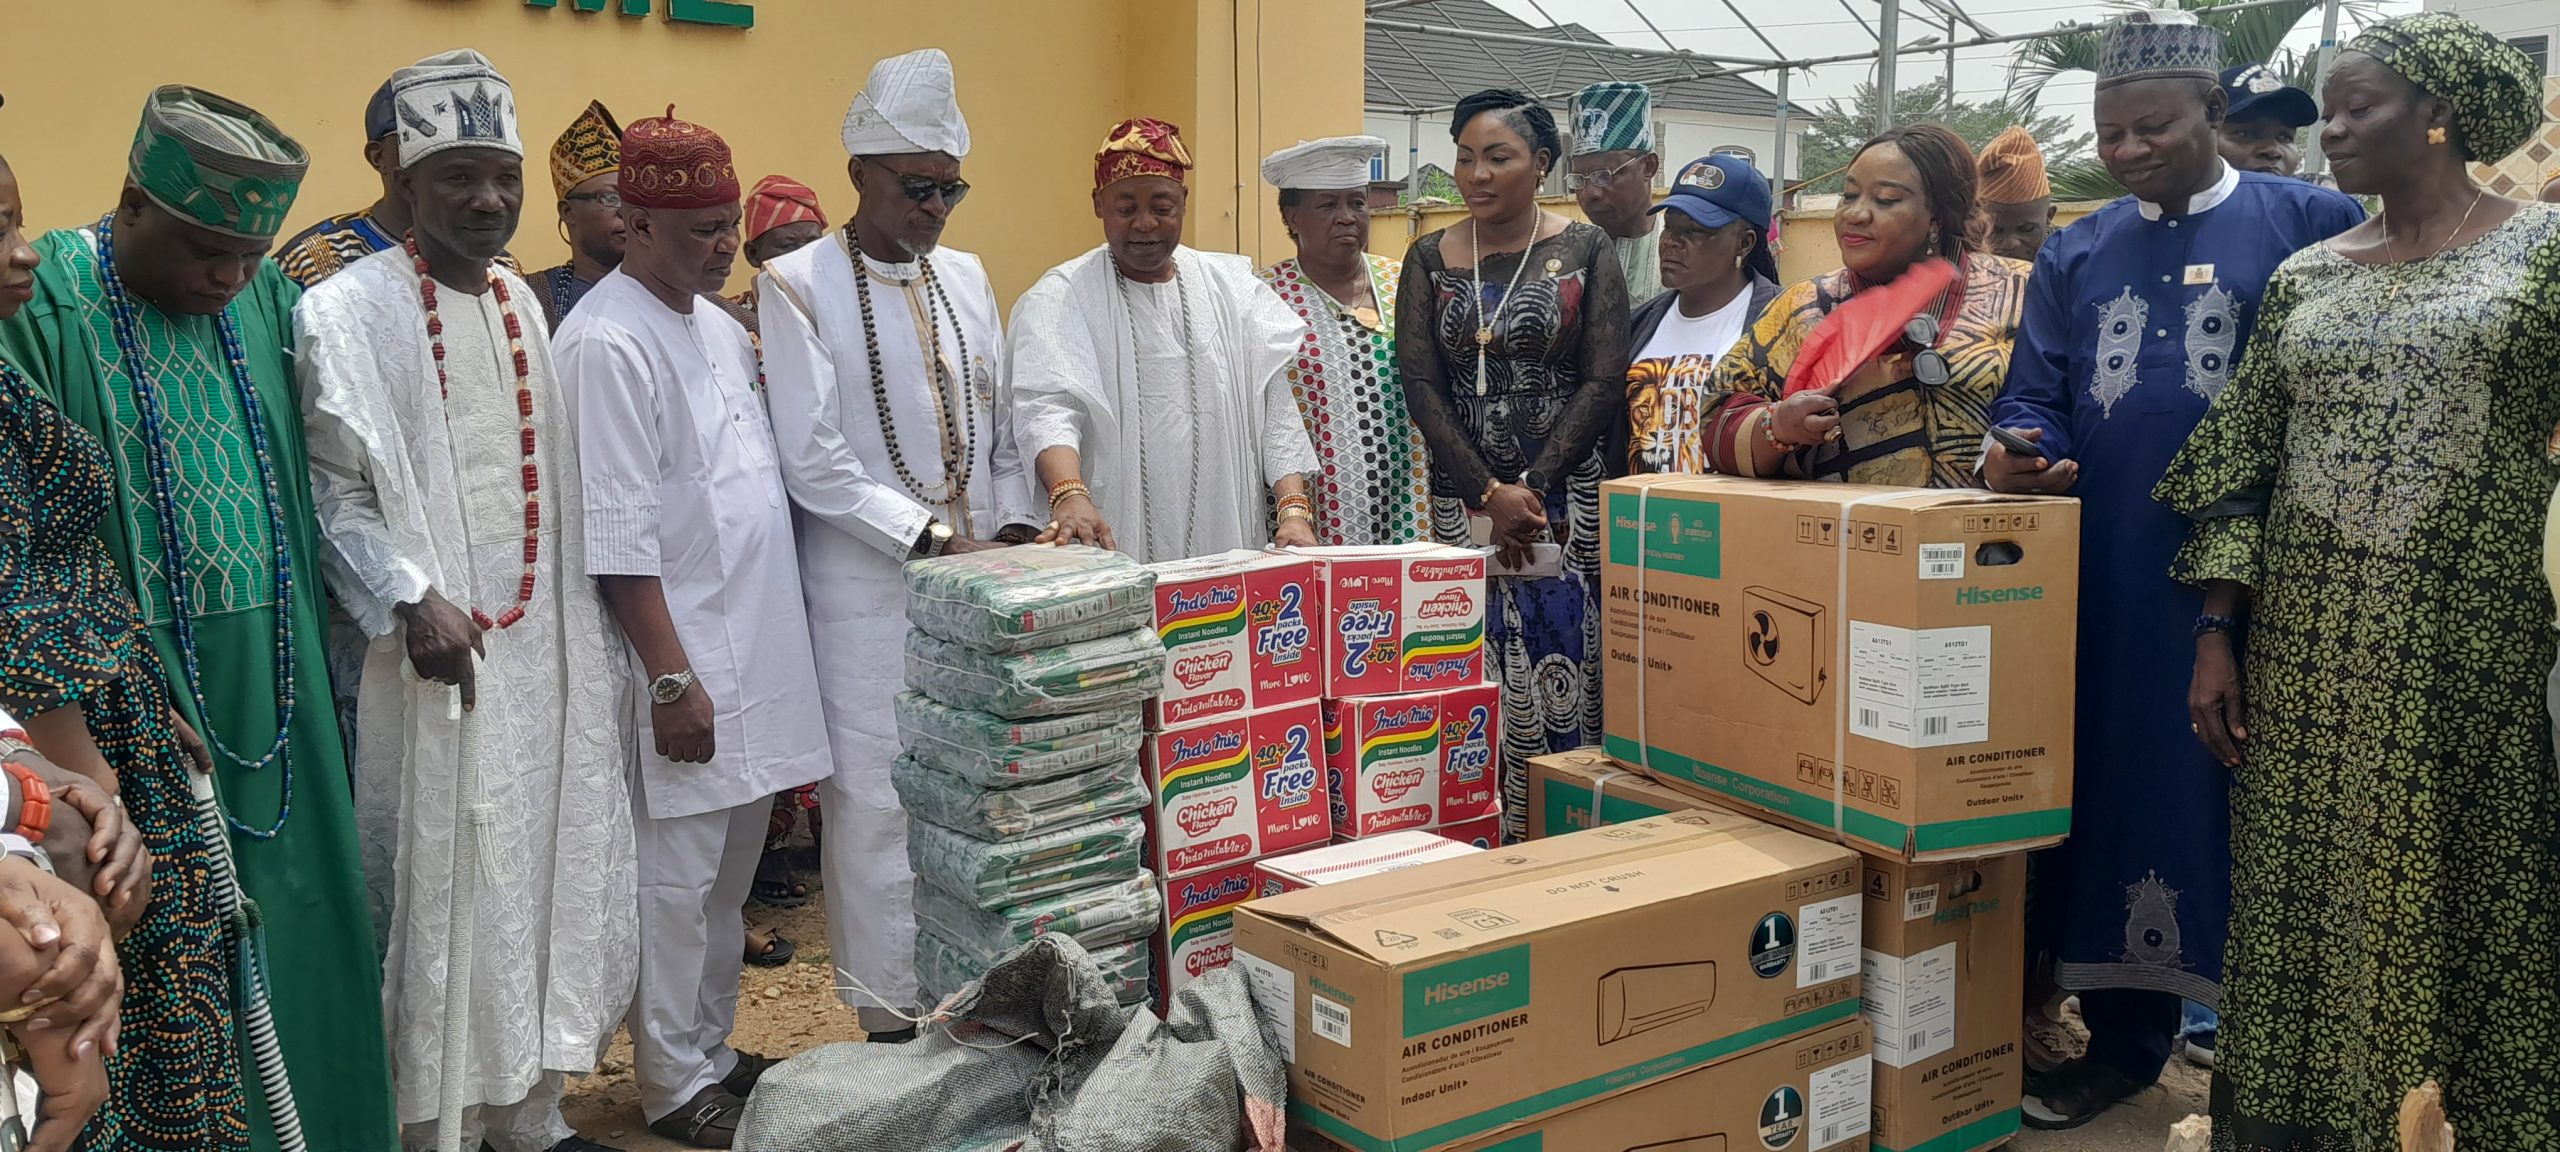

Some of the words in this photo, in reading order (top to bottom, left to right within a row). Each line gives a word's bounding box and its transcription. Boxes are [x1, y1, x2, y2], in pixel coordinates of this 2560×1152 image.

[1616, 515, 1658, 532] Hisese
[1371, 576, 1394, 587] More
[1437, 592, 1461, 602] Flavor
[1610, 585, 1629, 601] AIR
[1956, 585, 2044, 606] Hisense
[1161, 584, 1238, 623] Indomie
[1251, 600, 1282, 617] 40+
[1279, 584, 1303, 622] 2
[1350, 599, 1379, 611] Inside
[1422, 600, 1472, 616] Chicken
[1276, 618, 1302, 631] packs
[1341, 611, 1393, 636] Free
[1178, 628, 1202, 641] Instant
[1201, 625, 1229, 637] Noodles
[1259, 627, 1308, 653] Free
[1346, 633, 1373, 643] packs
[1420, 633, 1445, 644] Noodles
[1445, 632, 1467, 643] Instant
[1273, 650, 1301, 664] Inside
[1345, 642, 1371, 676] 2
[1368, 648, 1397, 663] 40+
[1611, 648, 1645, 665] Outdo
[1648, 656, 1668, 672] Unit
[1174, 654, 1229, 677] Chicken
[1188, 671, 1214, 684] Flavor
[1260, 679, 1282, 691] More
[1364, 704, 1434, 739] Indomie
[1443, 721, 1469, 737] 40+
[1466, 707, 1487, 741] 2
[1163, 731, 1242, 772] Indomie
[1255, 743, 1287, 761] 40+
[1284, 727, 1309, 764] 2
[1378, 746, 1399, 757] Instant
[1400, 744, 1423, 754] Noodles
[1464, 739, 1486, 749] packs
[1448, 748, 1489, 773] Free
[1946, 755, 1966, 767] AIR
[1969, 746, 2046, 764] CONDITIONER
[1283, 761, 1309, 774] packs
[1459, 769, 1482, 781] Inside
[1180, 778, 1204, 789] Instant
[1204, 772, 1232, 784] Noodles
[1264, 770, 1316, 797] Free
[1373, 771, 1421, 791] Chicken
[1692, 763, 1728, 787] Hisense
[1732, 777, 1790, 806] Corporation
[1280, 793, 1309, 807] Inside
[1384, 786, 1407, 797] Flavor
[1966, 797, 2000, 808] Outdoor
[2002, 793, 2019, 803] Unit
[1446, 795, 1465, 807] More
[1178, 801, 1234, 823] Chicken
[1191, 818, 1219, 830] Flavor
[1267, 823, 1290, 836] More
[1545, 886, 1568, 896] DO
[1568, 880, 1597, 890] NOT
[1598, 870, 1646, 885] CRUSH
[1872, 874, 1883, 890] 4
[1172, 873, 1250, 919] Indomie
[1189, 921, 1212, 935] Instant
[1212, 915, 1233, 927] Noodl
[1764, 916, 1780, 950] 1
[1187, 945, 1233, 970] Chicke
[1424, 970, 1510, 1007] Hisense
[1401, 1041, 1427, 1059] AIR
[1431, 1013, 1529, 1051] CONDITIONER
[1921, 1068, 1939, 1085] AIR
[1942, 1042, 2015, 1076] CONDITIONER
[1304, 1067, 1316, 1080] AIR
[1317, 1074, 1366, 1104] CONDITIONER
[1401, 1088, 1437, 1106] Indoor
[1439, 1079, 1461, 1095] Unit
[1774, 1087, 1789, 1123] 1
[1942, 1106, 1973, 1125] Outdoor
[1974, 1099, 1990, 1113] Unit
[1769, 1119, 1794, 1134] YEAR
